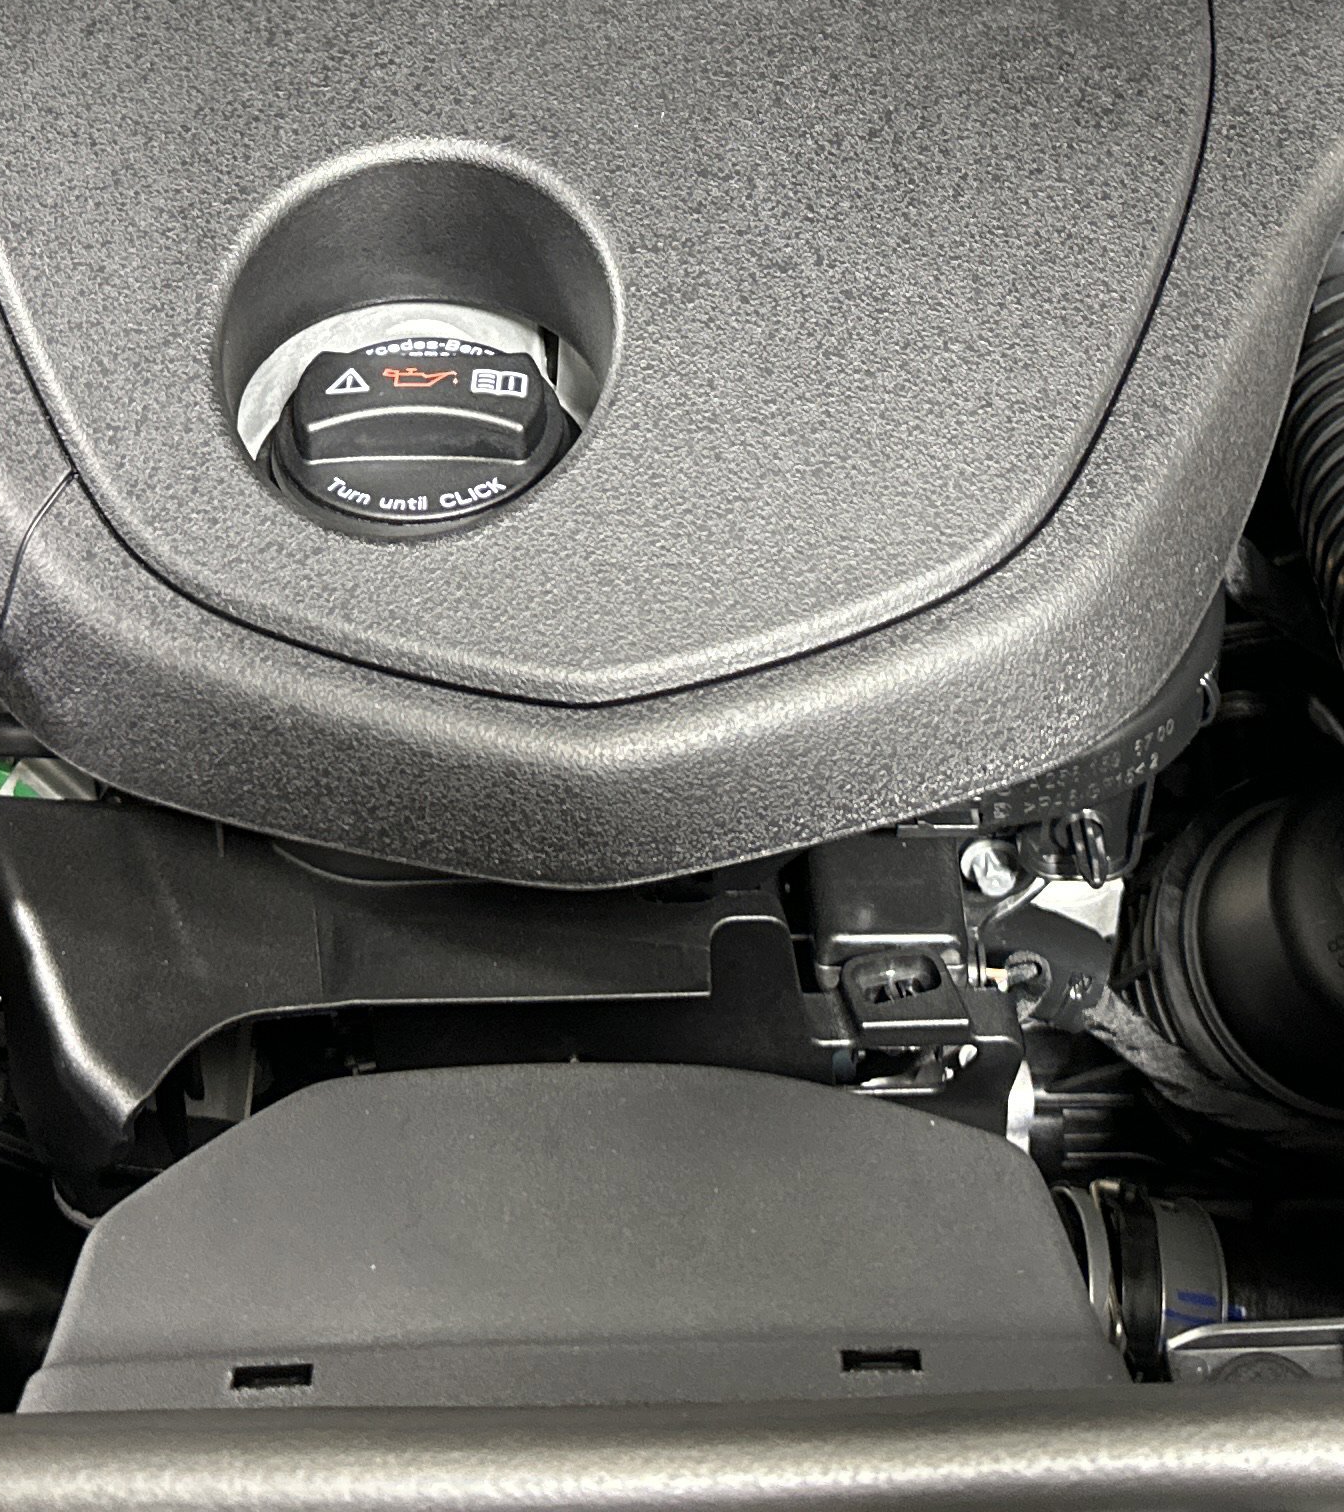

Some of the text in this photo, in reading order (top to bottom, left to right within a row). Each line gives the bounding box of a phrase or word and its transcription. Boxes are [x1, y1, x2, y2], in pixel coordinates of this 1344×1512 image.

[327, 476, 507, 511] Turn until CLICK
